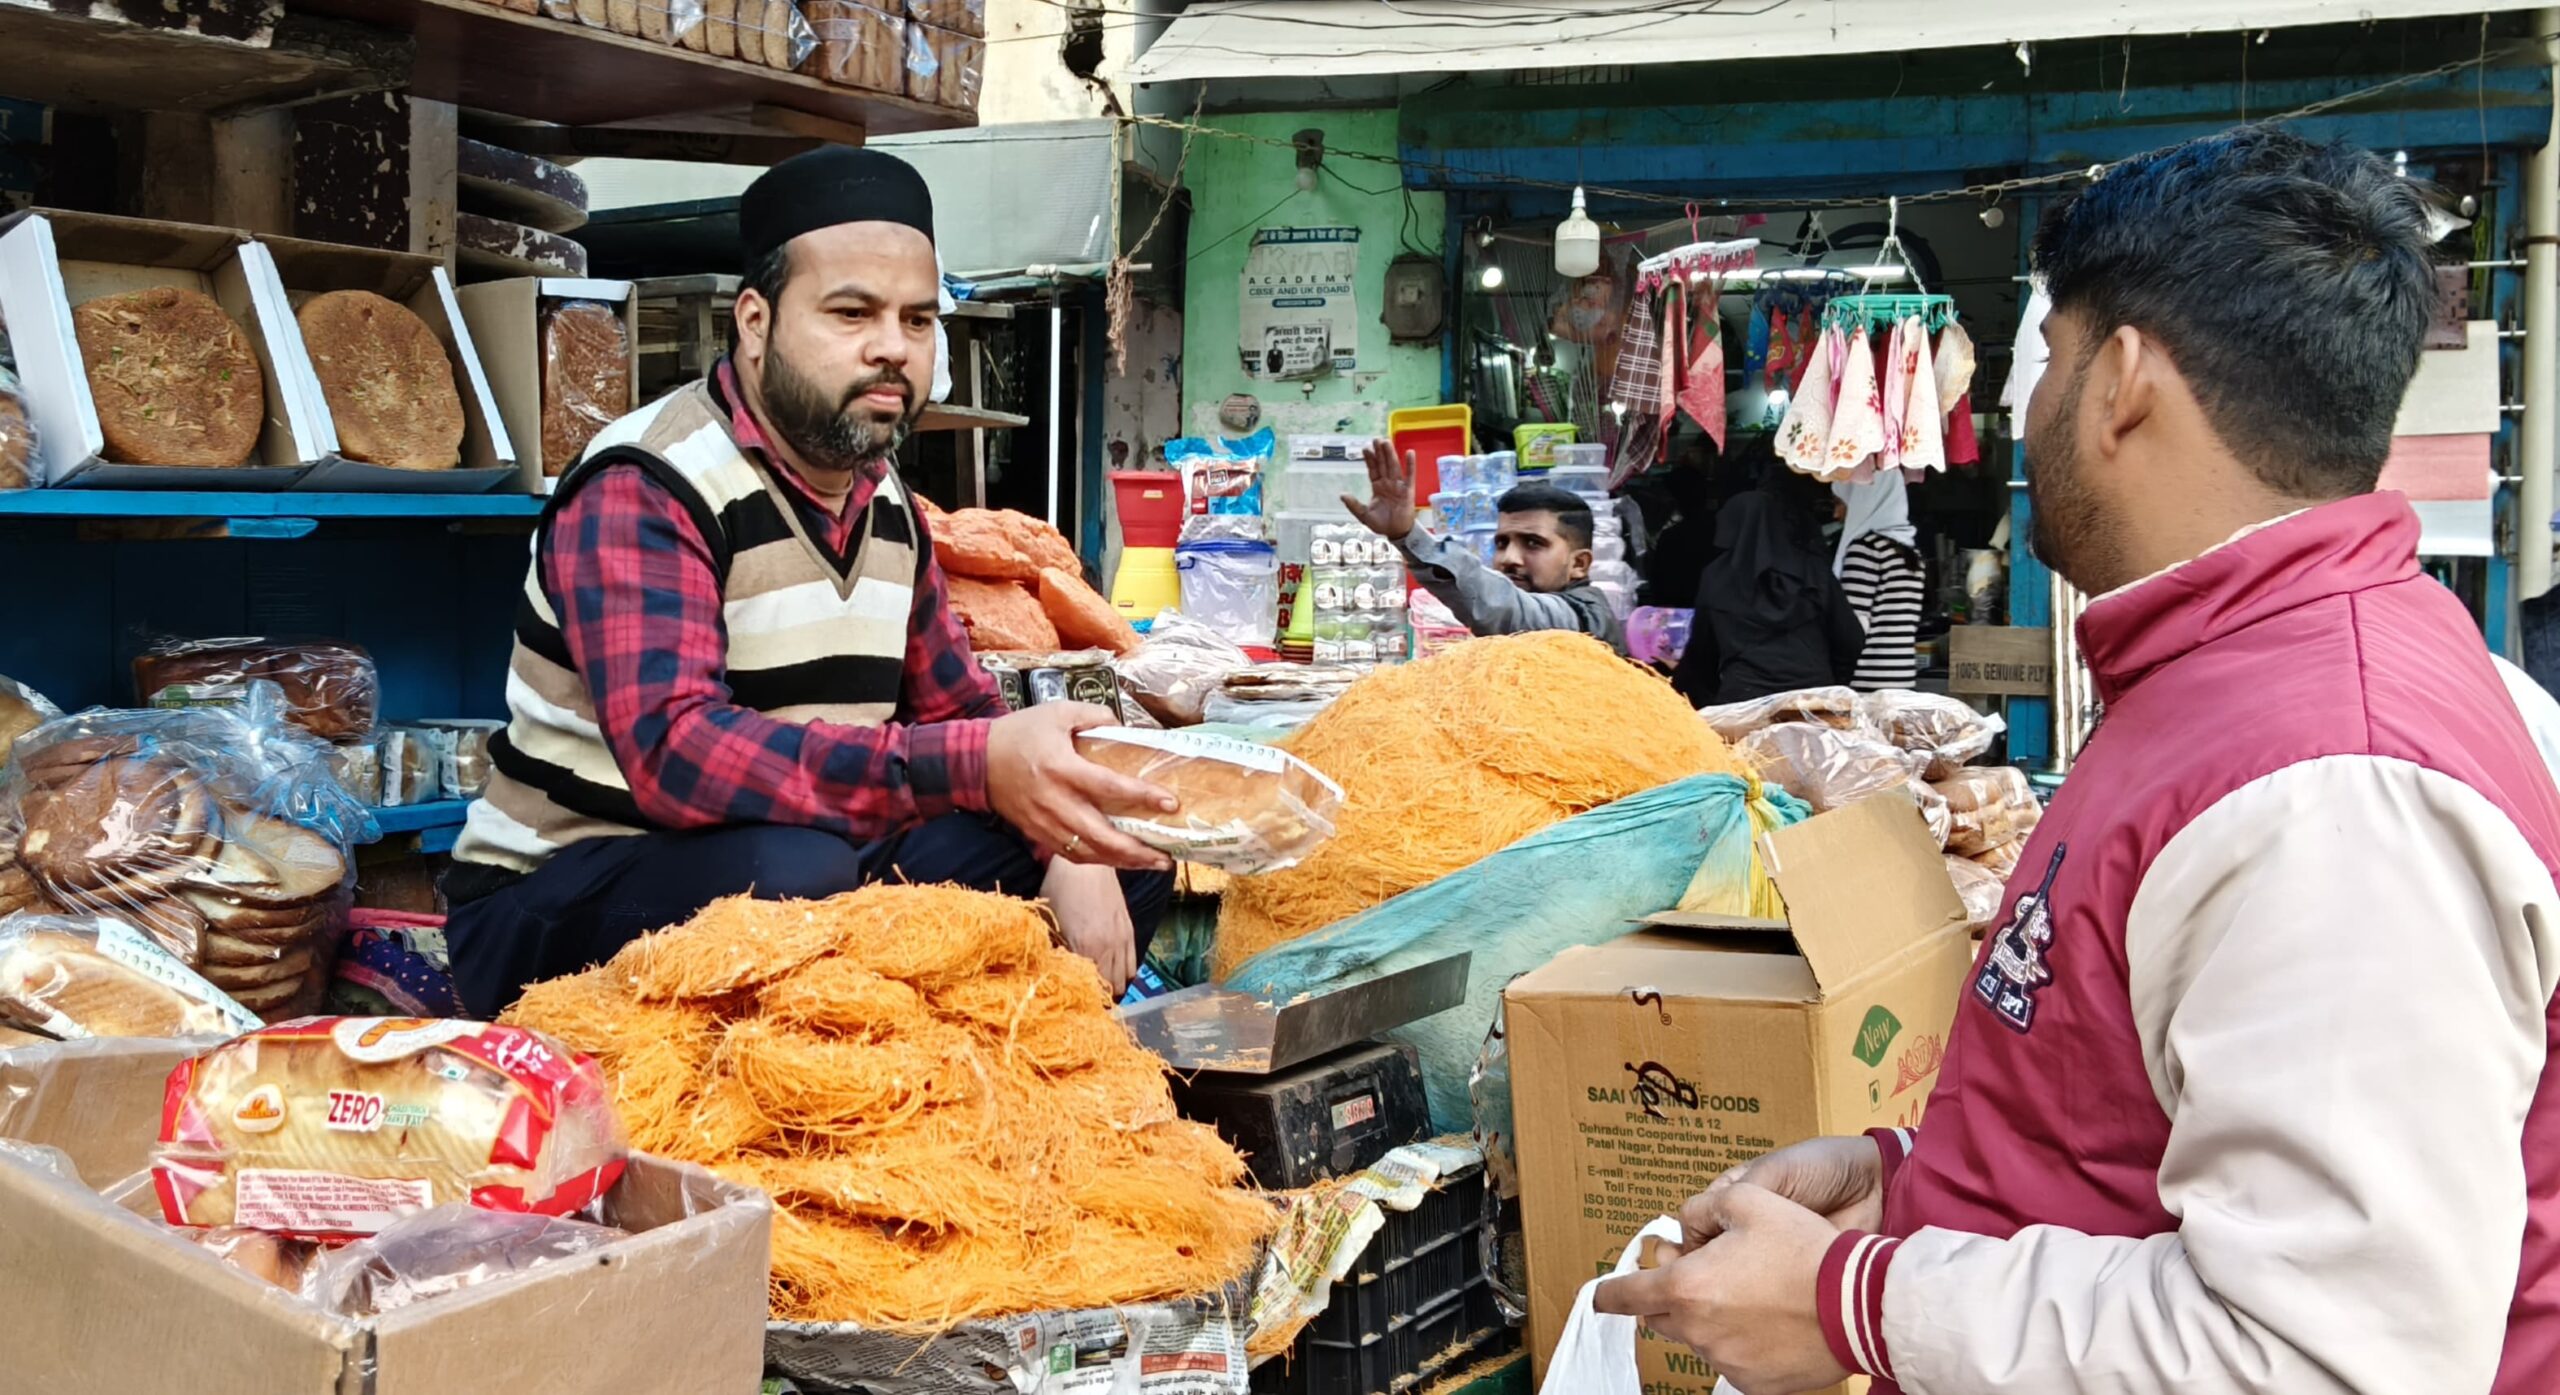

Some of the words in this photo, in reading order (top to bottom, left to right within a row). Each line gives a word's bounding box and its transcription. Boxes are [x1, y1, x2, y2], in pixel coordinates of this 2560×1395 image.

[1249, 275, 1352, 285] ACADEMY
[1249, 287, 1275, 297] CBSE
[1277, 286, 1298, 296] AND
[1300, 285, 1314, 295] UK
[1316, 284, 1350, 295] BOARD
[1955, 662, 1981, 680] 100%
[1983, 662, 2025, 682] GENUINE
[2027, 664, 2046, 682] PLY
[1862, 1018, 1890, 1058] New
[327, 1092, 381, 1126] ZERO
[1587, 1086, 1626, 1104] SAAI
[1700, 1094, 1760, 1113] FOODS
[1625, 1111, 1649, 1124] Plot
[1694, 1117, 1704, 1129] &
[1707, 1118, 1722, 1130] 12
[1579, 1122, 1633, 1137] Dehradun
[1636, 1127, 1707, 1144] Cooperative
[1709, 1133, 1733, 1145] Ind.
[1735, 1135, 1775, 1149] Estate
[1586, 1137, 1615, 1150] Patel
[1617, 1139, 1656, 1155] Nagar,
[1657, 1143, 1715, 1158] Dehradun
[1587, 1165, 1624, 1178] E-mail
[1618, 1154, 1690, 1170] Uttarakhand
[1603, 1180, 1625, 1193] Toll
[1627, 1183, 1653, 1197] Free
[1584, 1193, 1605, 1206] ISO
[1607, 1195, 1664, 1212] 9001:2008
[1583, 1207, 1604, 1219] ISO
